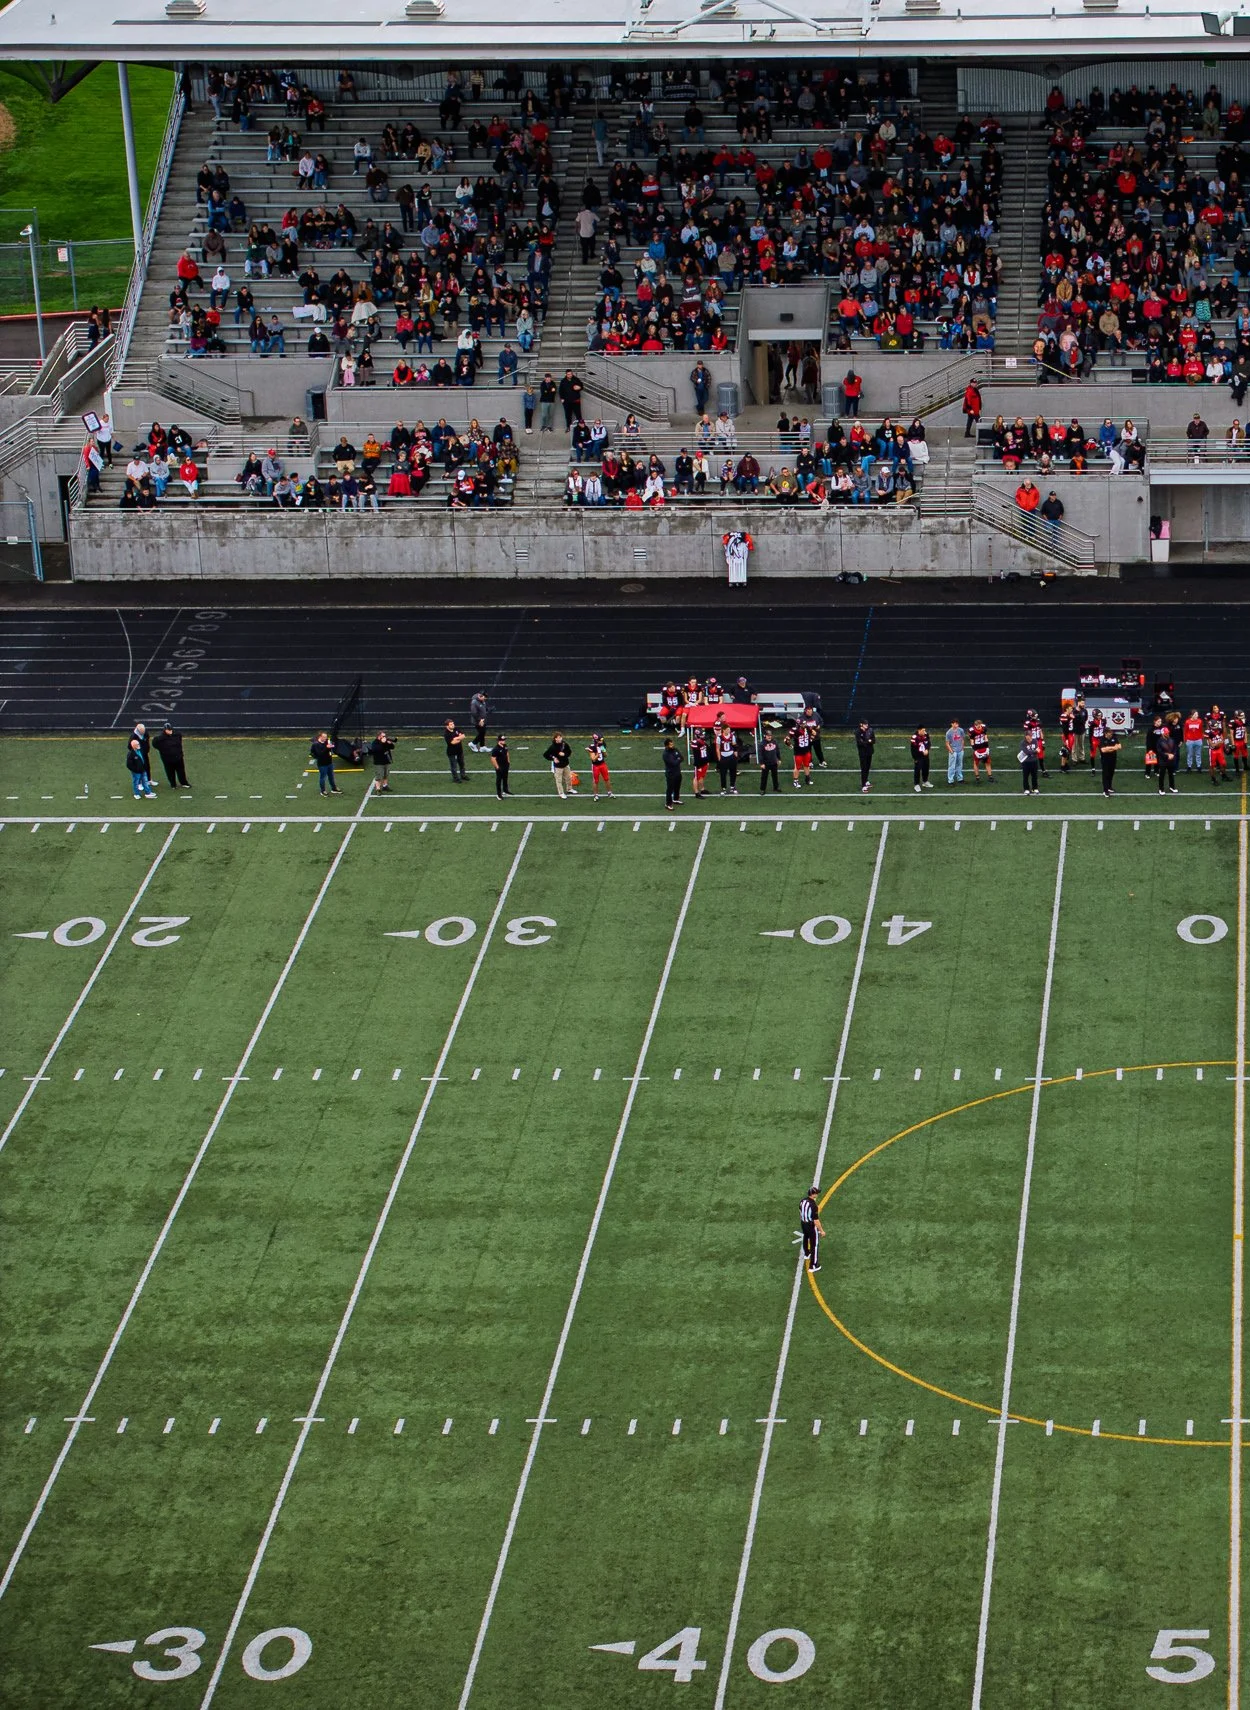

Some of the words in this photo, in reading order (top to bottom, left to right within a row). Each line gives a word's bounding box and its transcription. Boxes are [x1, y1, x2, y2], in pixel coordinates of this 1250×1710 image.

[195, 611, 227, 619] 9
[187, 624, 220, 632] 8
[178, 636, 212, 644] 7
[172, 649, 206, 658] 6
[164, 662, 199, 670] 5
[157, 676, 192, 684] 4
[149, 689, 184, 698] 3
[141, 702, 177, 711] 2
[132, 1626, 312, 1681] 30
[637, 1627, 815, 1682] 40
